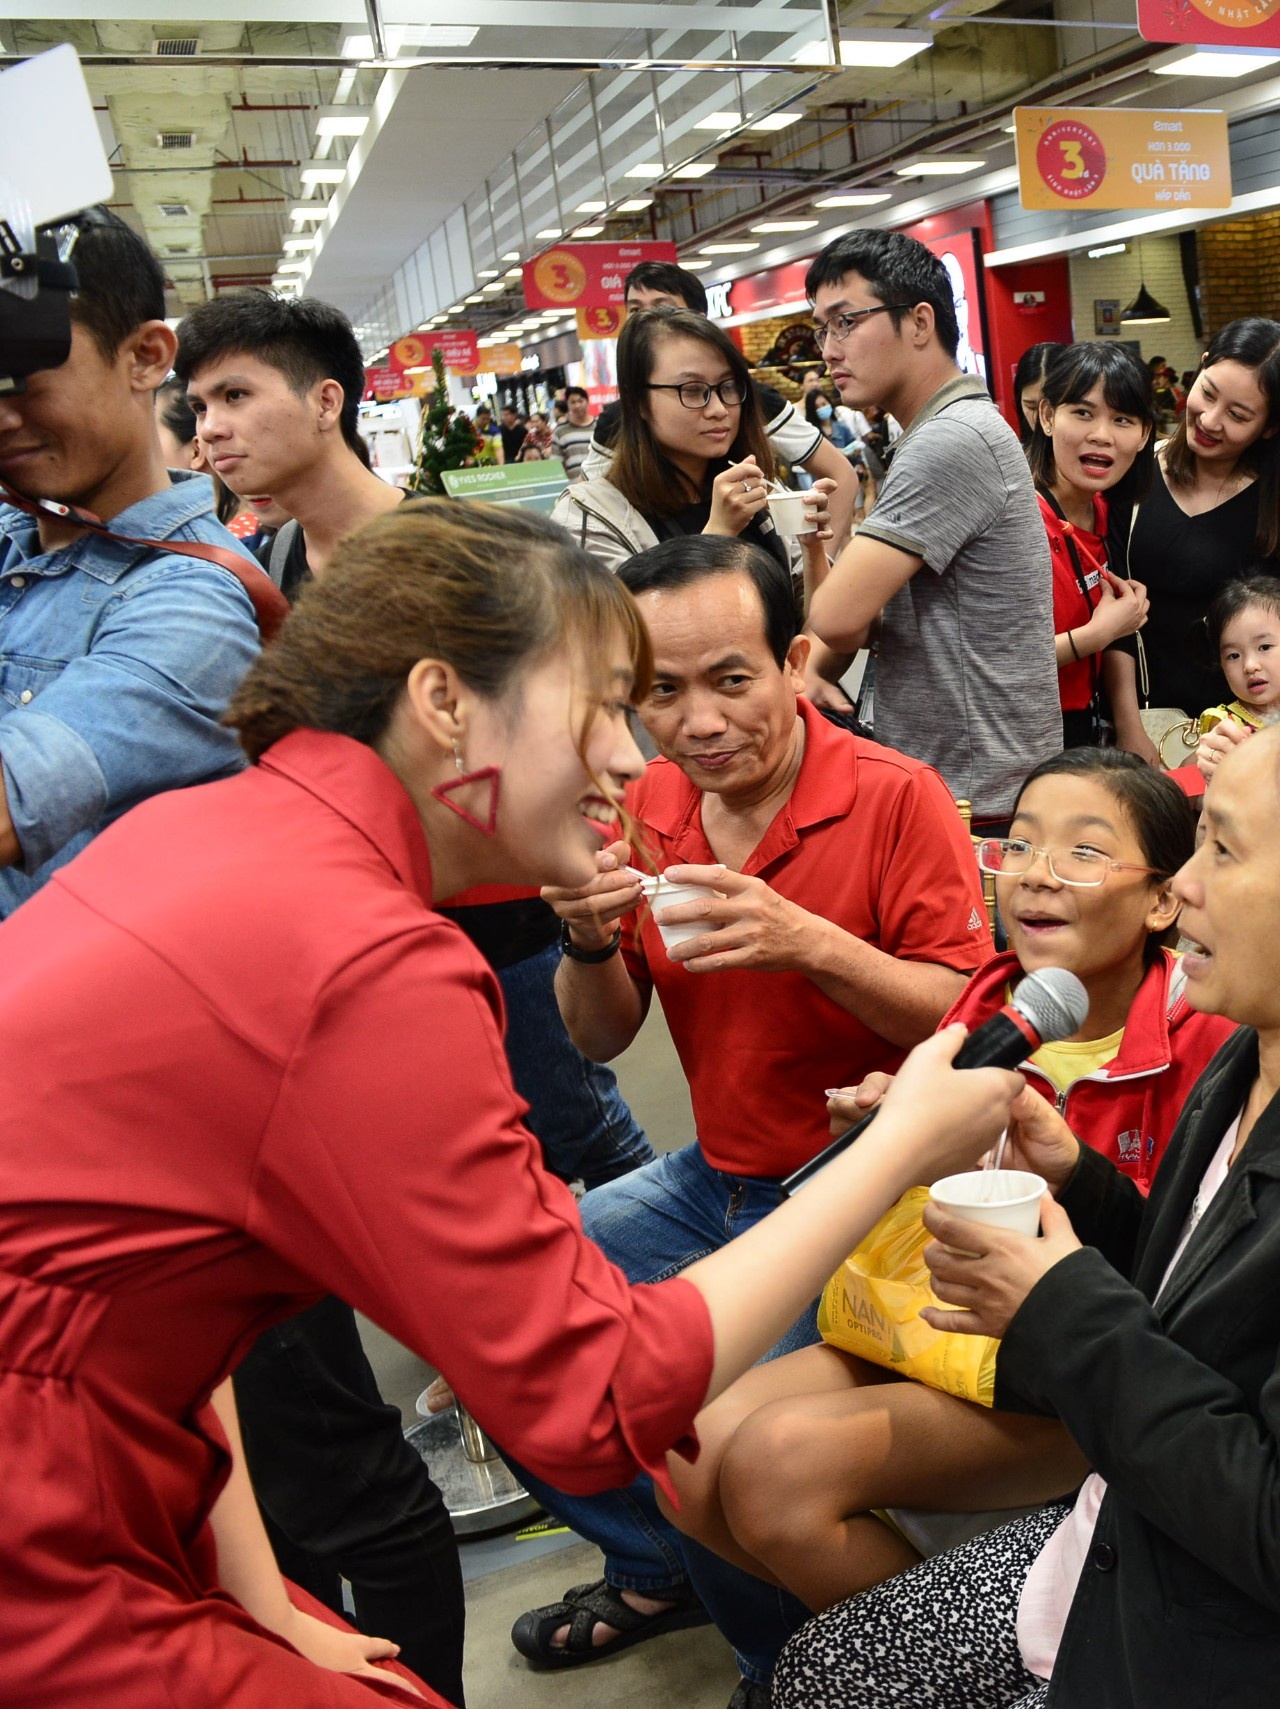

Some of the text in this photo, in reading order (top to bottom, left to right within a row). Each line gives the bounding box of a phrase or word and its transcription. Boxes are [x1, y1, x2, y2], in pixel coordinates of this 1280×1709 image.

[1154, 120, 1183, 132] emart
[1131, 160, 1210, 184] QUÀ TẶNG
[842, 1288, 886, 1330] NAN
[847, 1319, 883, 1342] OPTIPRO
